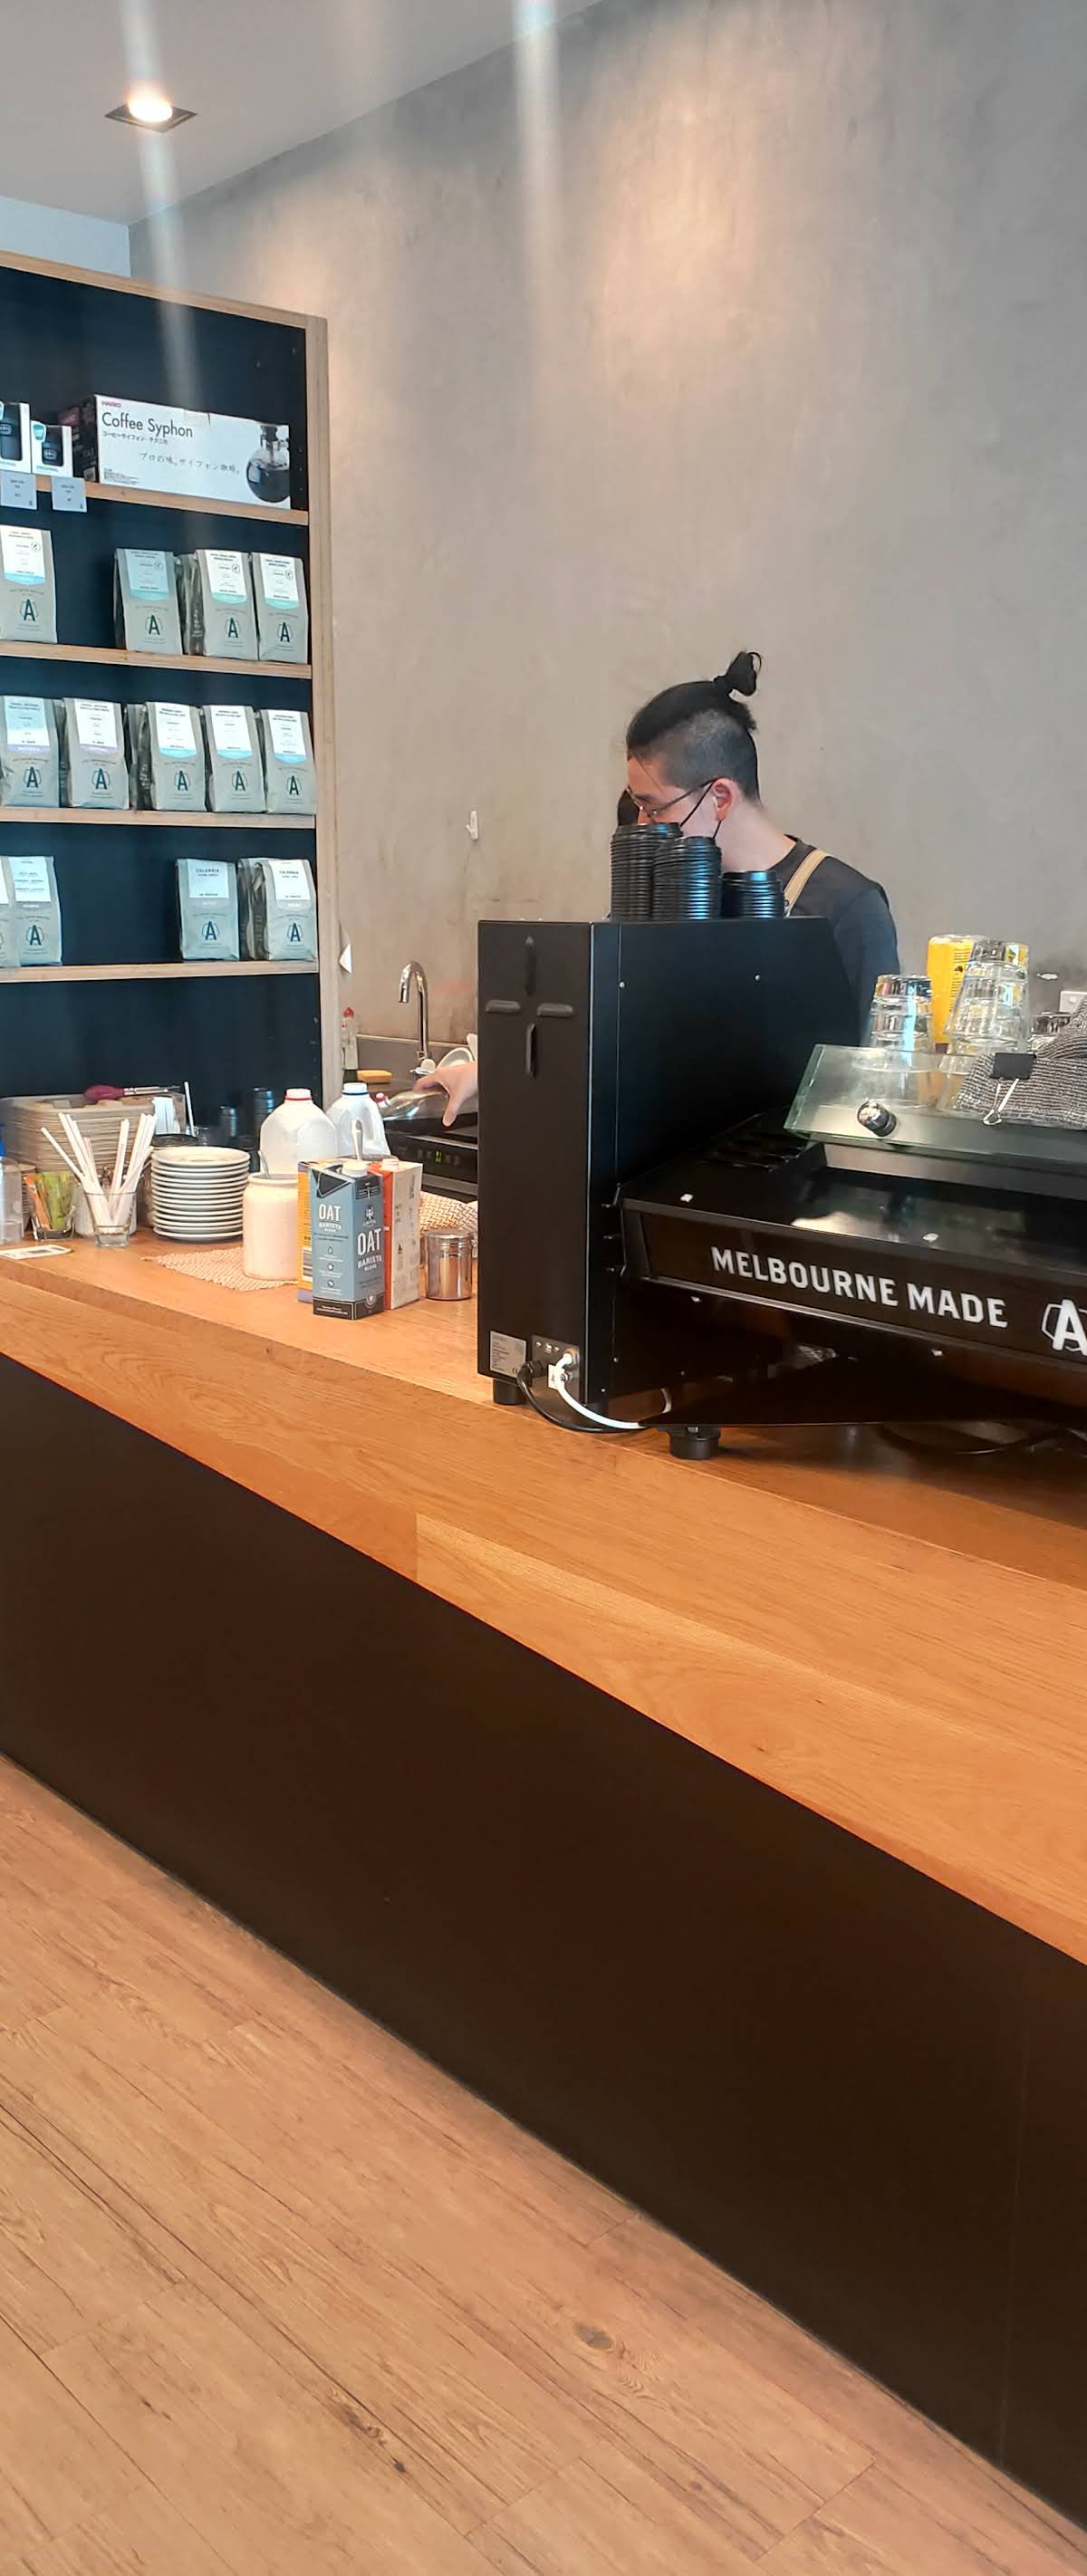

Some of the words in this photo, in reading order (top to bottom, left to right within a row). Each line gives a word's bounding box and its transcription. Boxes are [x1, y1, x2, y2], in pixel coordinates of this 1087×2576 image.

[101, 412, 143, 430] Coffee
[148, 418, 193, 437] Syphon
[319, 1203, 341, 1222] OAT
[318, 1221, 341, 1230] BARISTA
[358, 1227, 382, 1256] OAT
[357, 1254, 382, 1269] BARISTA
[710, 1245, 899, 1307] MELBOURNE
[906, 1282, 1008, 1328] MADE
